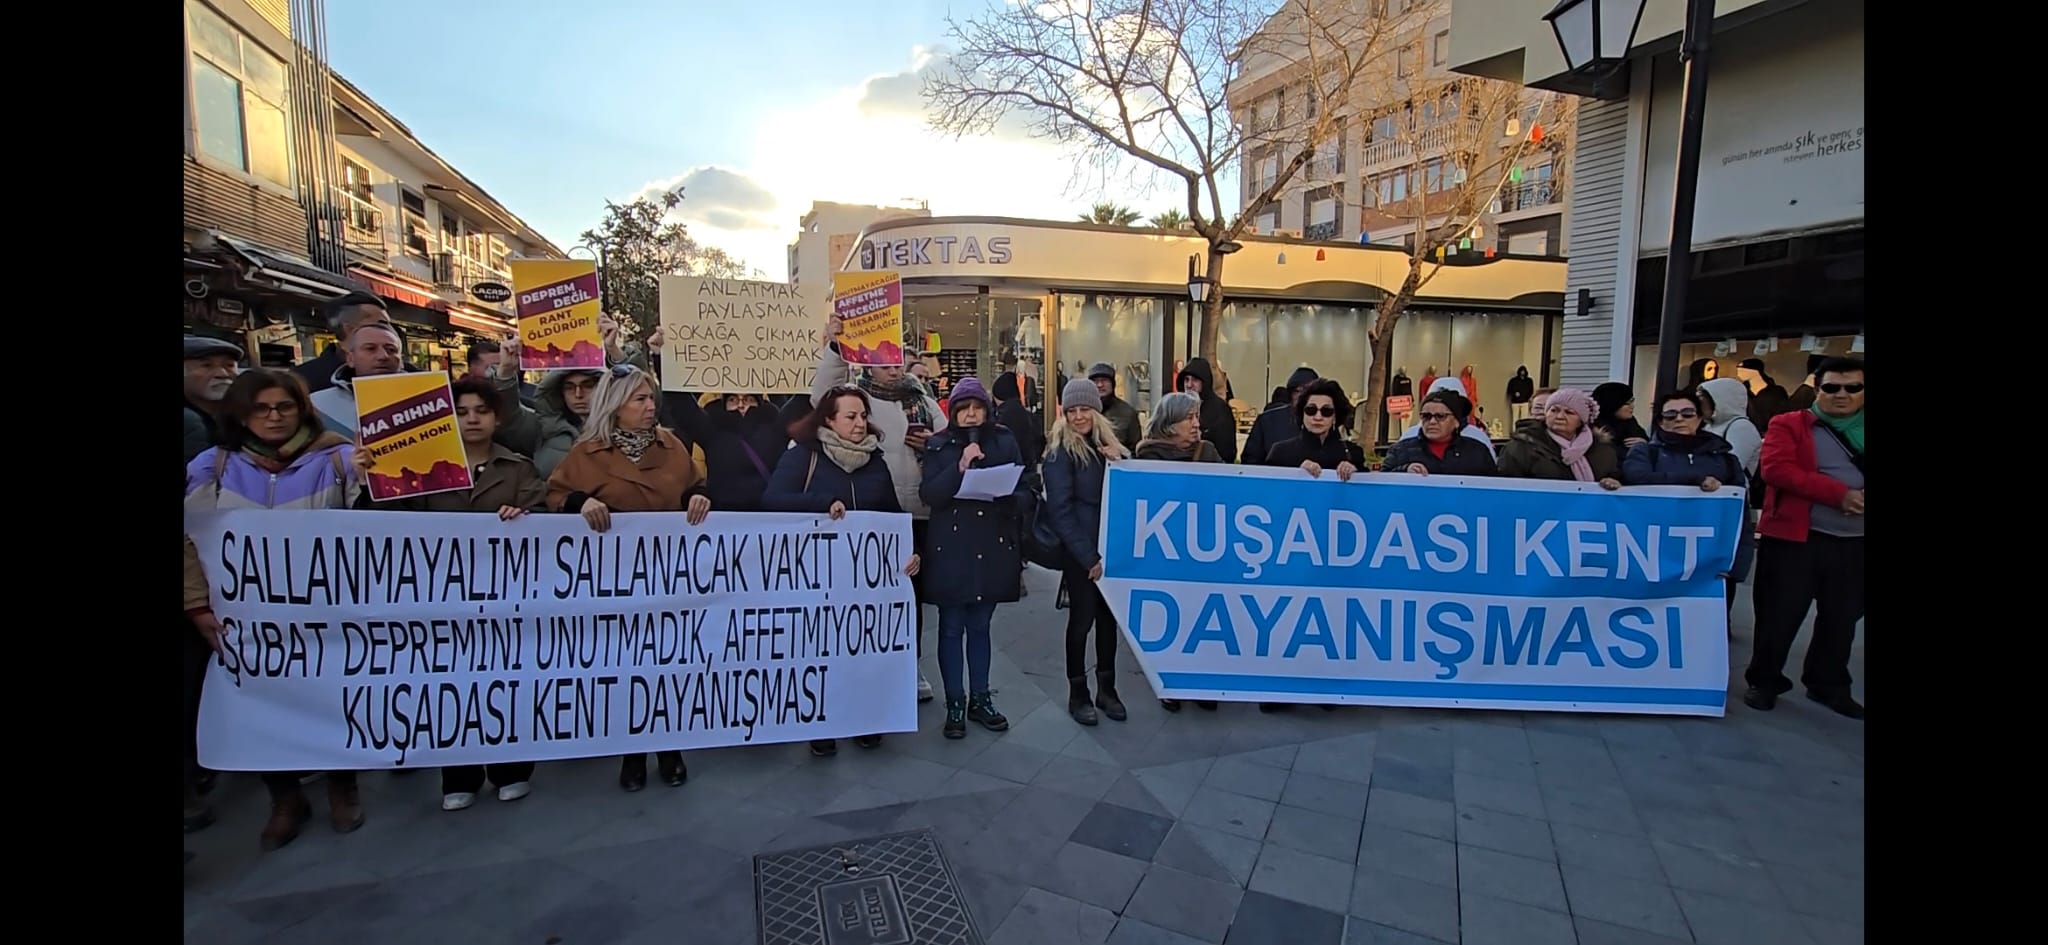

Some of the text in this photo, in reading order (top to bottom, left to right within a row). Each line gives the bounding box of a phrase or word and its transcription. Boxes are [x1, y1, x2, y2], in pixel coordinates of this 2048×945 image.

[1748, 147, 1763, 159] her
[1795, 130, 1816, 152] şık
[1829, 129, 1852, 142] genç
[1816, 138, 1862, 158] herkes
[876, 236, 1013, 269] TEKTAS
[521, 282, 576, 305] DEPREM
[553, 289, 592, 309] DEĞİL
[698, 280, 804, 299] ANLATMAK
[539, 309, 573, 326] RANT
[698, 302, 809, 320] PAYLAŞMAK
[527, 317, 590, 341] ÖLDÜRÜR!
[668, 322, 819, 344] SOKAĞA ÇIKMAK
[674, 344, 824, 363] HESAP SORMAK
[362, 397, 449, 439] MA RIHNA
[371, 423, 452, 459] NEHNA HON!
[1132, 498, 1715, 583] KUŞADASI KENT
[553, 534, 749, 600] SALLANACAK
[758, 519, 839, 592] VAKİT
[846, 531, 901, 590] YOK!
[218, 593, 911, 688] ŞUBAT DEPREMİNİ UNUTMADIK, AFFETMİYORUZ!
[1128, 589, 1684, 680] DAYANIŞMASI
[342, 665, 829, 766] KUŞADASI KENT DAYANIŞMASI
